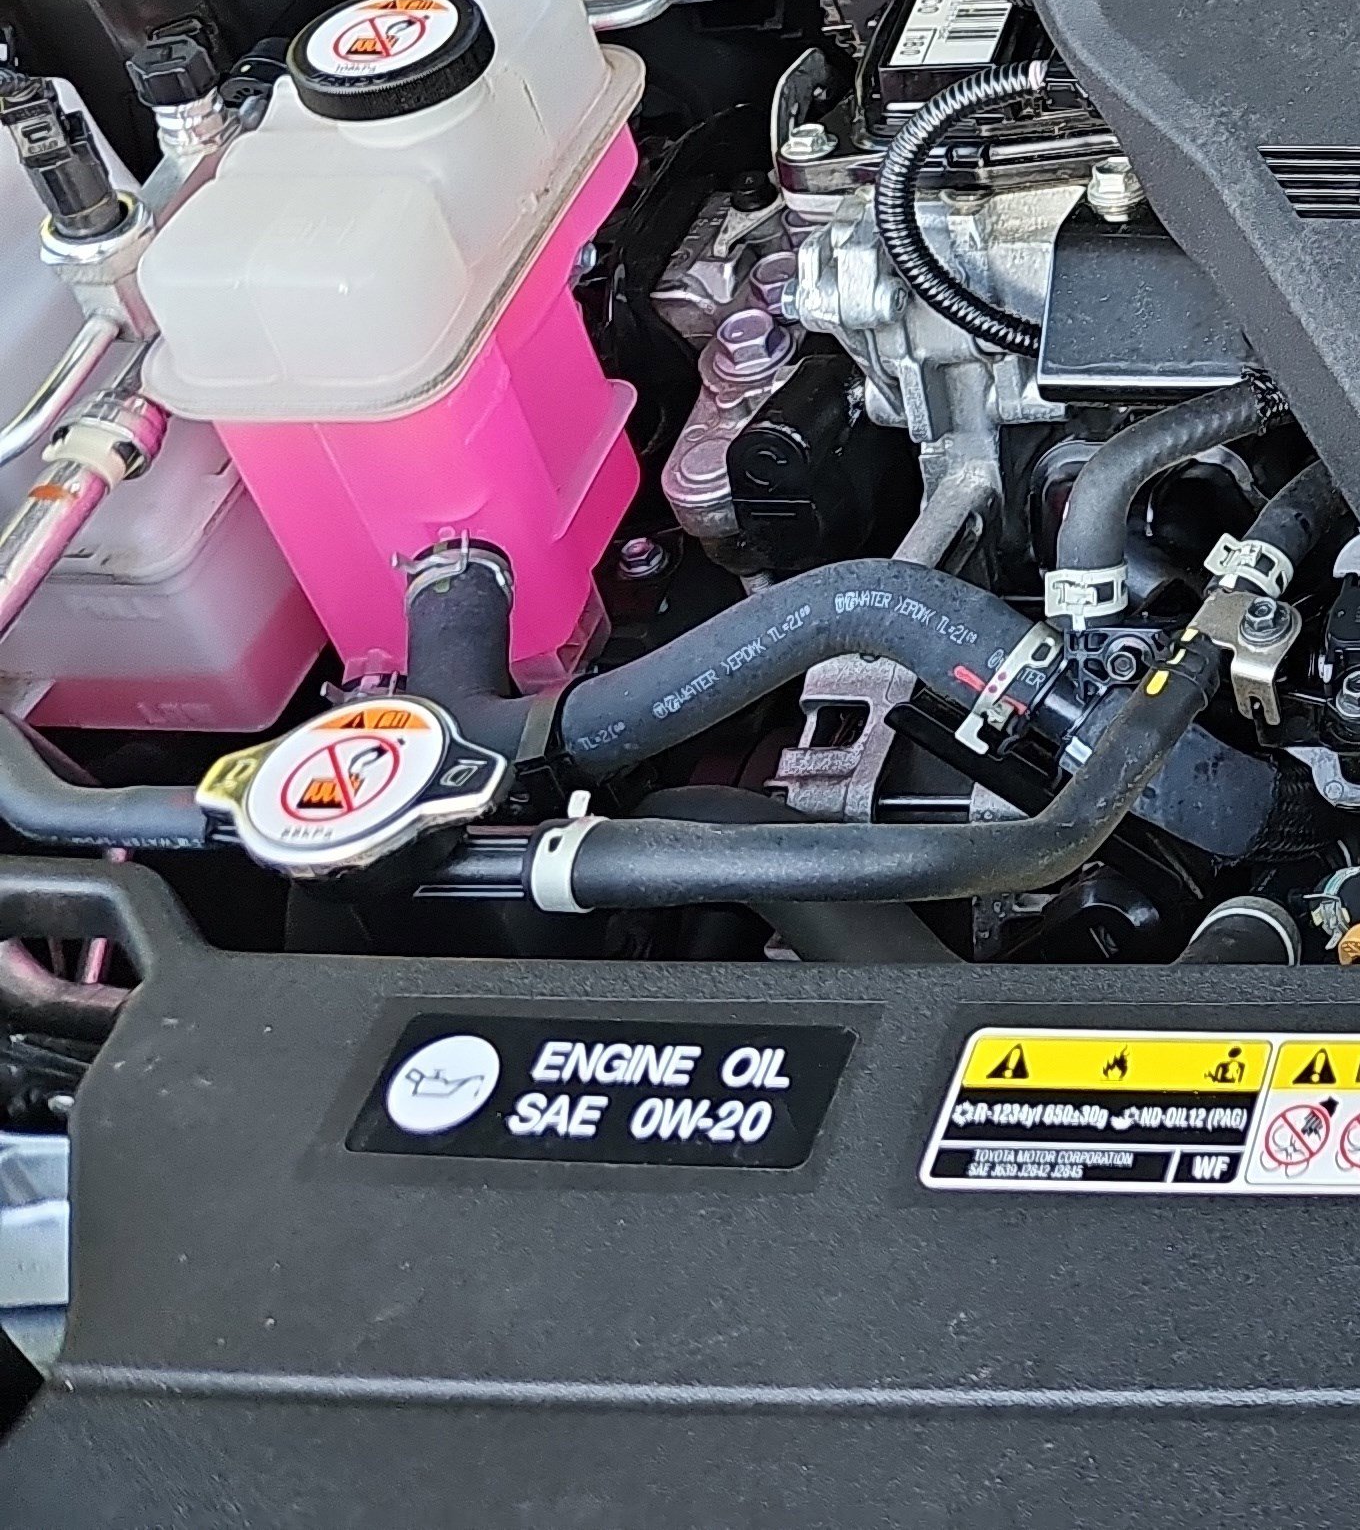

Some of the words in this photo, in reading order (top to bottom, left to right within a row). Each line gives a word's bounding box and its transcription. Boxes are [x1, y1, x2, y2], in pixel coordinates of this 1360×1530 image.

[674, 669, 721, 705] WATER
[531, 1040, 702, 1087] ENGINE
[721, 1046, 792, 1091] OIL
[506, 1092, 609, 1138] SAE
[630, 1096, 773, 1143] 0W-20
[967, 1162, 992, 1178] SAE
[973, 1148, 1016, 1164] TOYOTA
[1016, 1149, 1056, 1164] MOTOR
[1056, 1150, 1134, 1168] CORPORATION
[1191, 1154, 1231, 1180] WF
